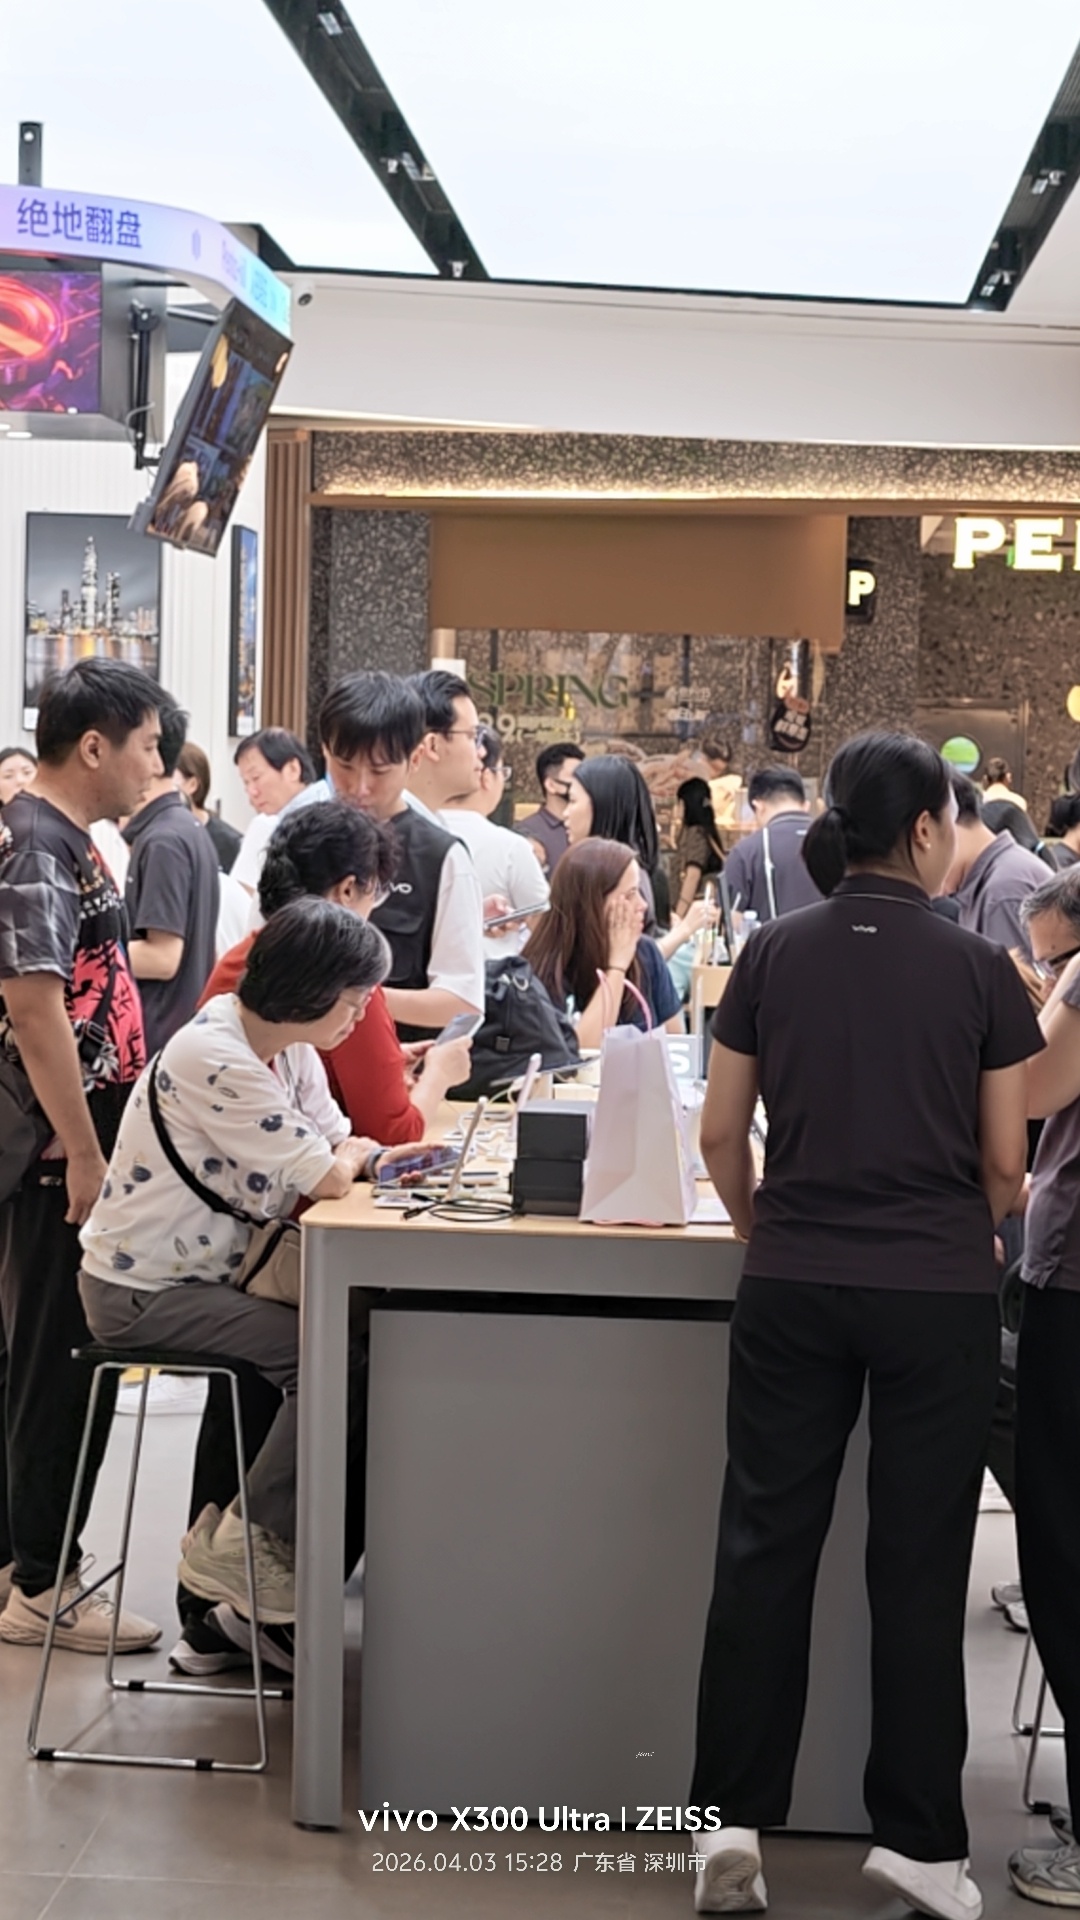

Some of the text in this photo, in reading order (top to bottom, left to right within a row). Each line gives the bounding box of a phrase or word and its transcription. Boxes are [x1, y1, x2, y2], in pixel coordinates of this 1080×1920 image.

[16, 198, 143, 249] 绝地翻盘
[952, 517, 1080, 572] PE
[467, 672, 629, 709] SPRING
